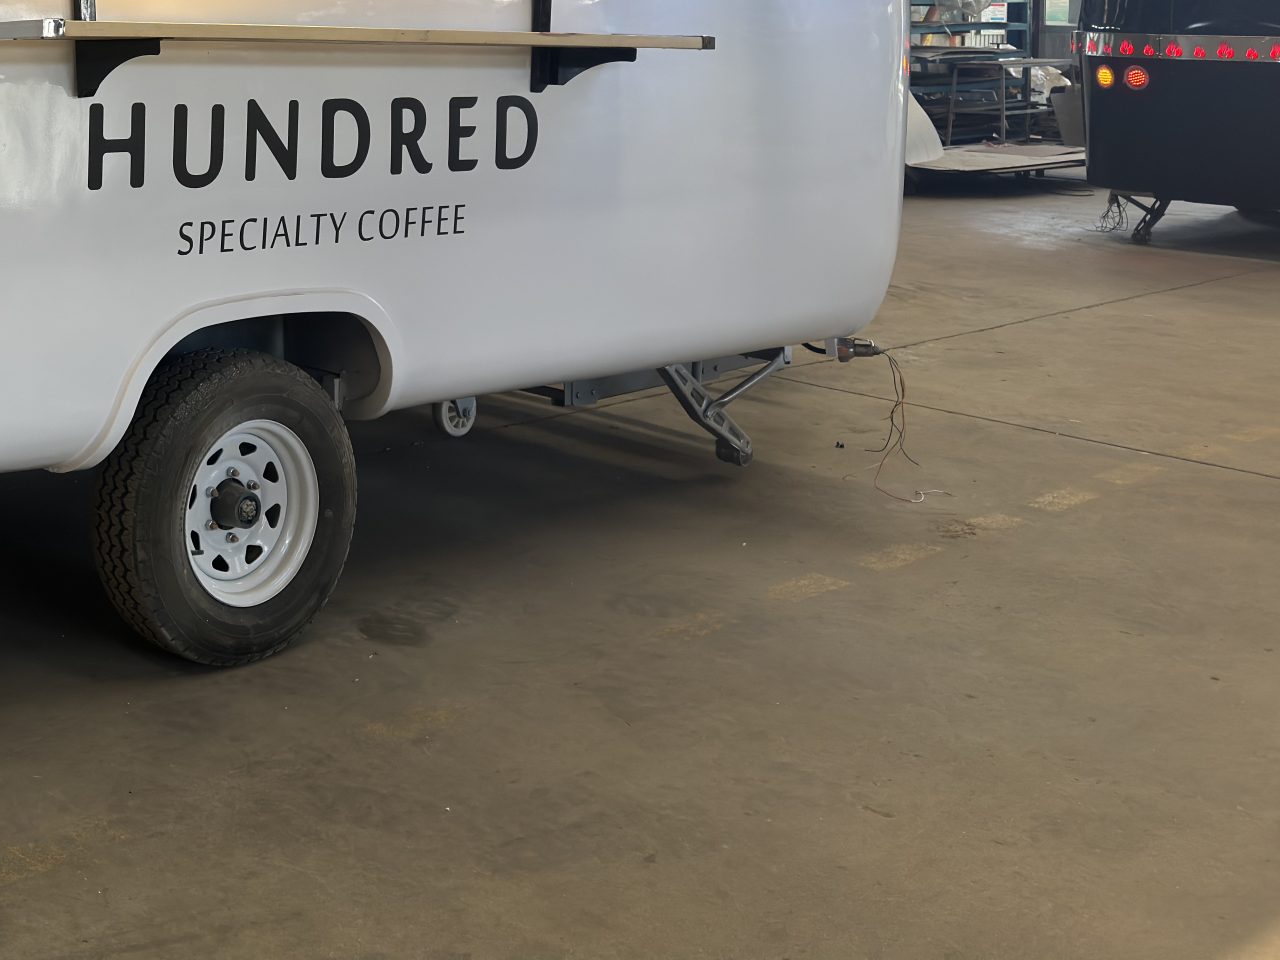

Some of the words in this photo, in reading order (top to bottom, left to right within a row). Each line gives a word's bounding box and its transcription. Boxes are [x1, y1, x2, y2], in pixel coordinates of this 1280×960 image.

[87, 95, 539, 191] HUNDRED
[177, 211, 348, 256] SPECIALTY
[358, 203, 466, 242] COFFEE
